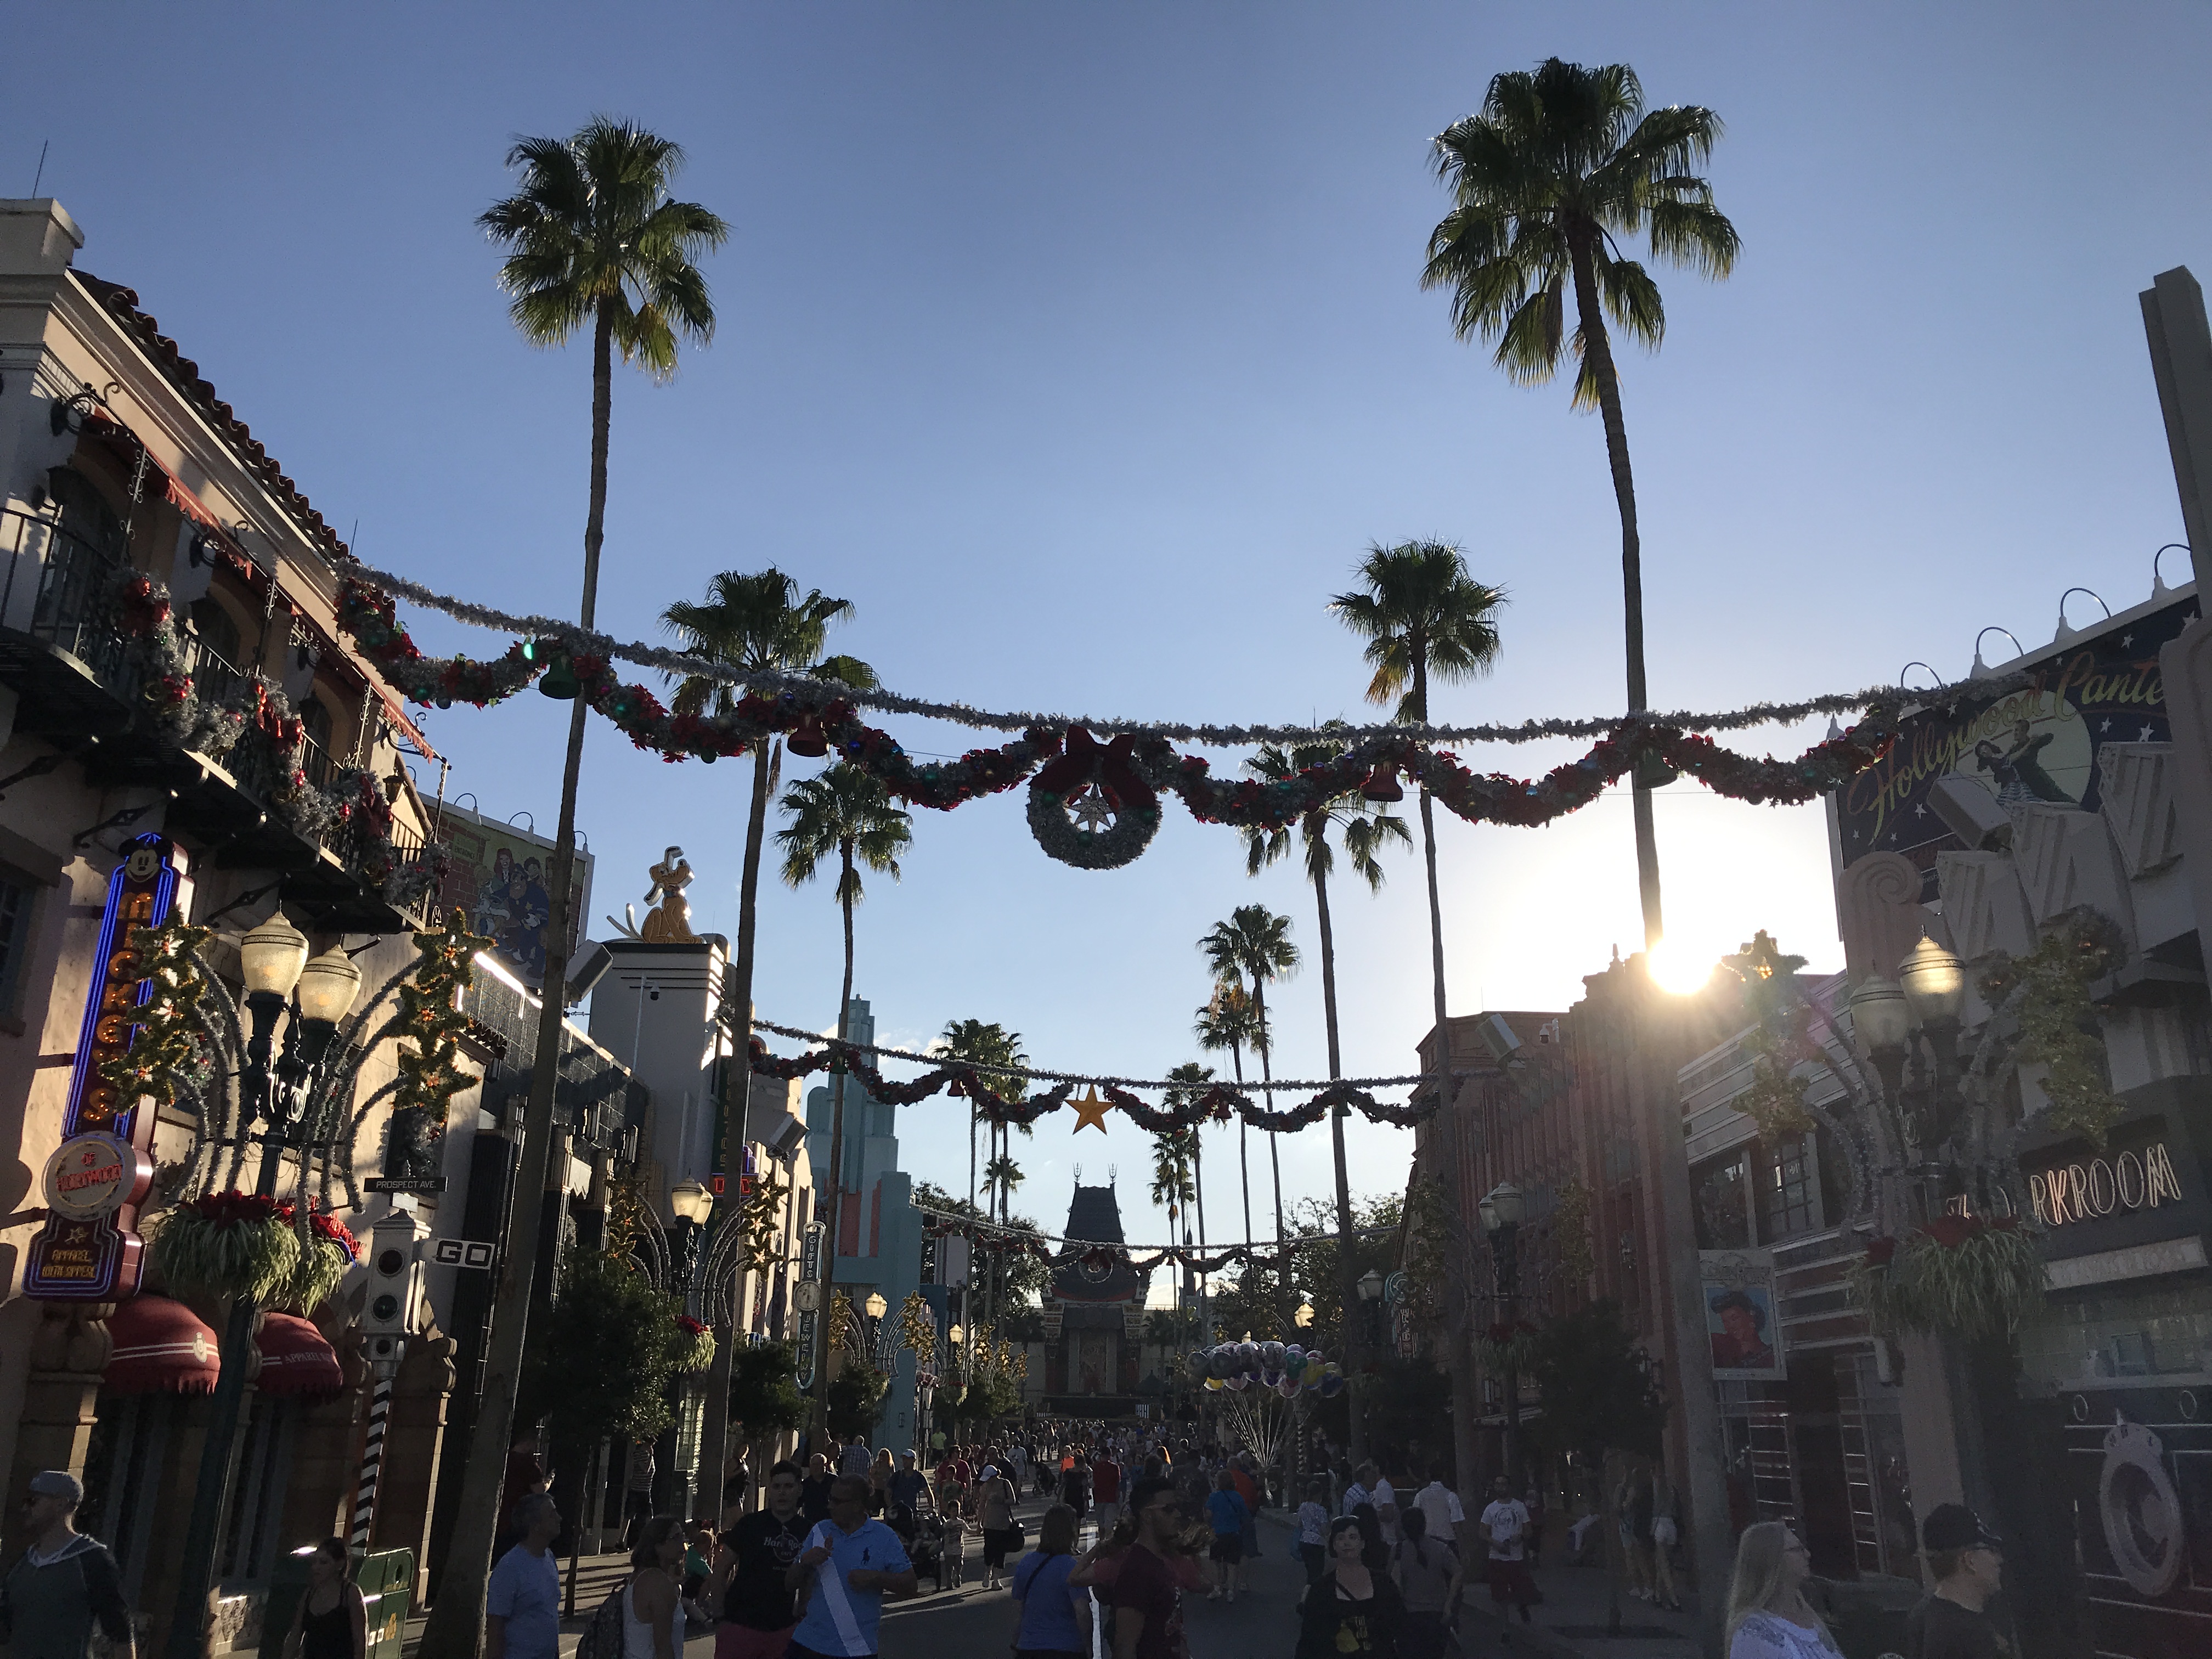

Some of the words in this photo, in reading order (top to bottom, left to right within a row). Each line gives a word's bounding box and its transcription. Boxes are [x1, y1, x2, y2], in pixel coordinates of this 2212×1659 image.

[1847, 670, 2049, 845] Hollywood
[2053, 650, 2164, 721] Cante
[1997, 1143, 2182, 1226] RKROOM
[436, 1240, 491, 1267] GO
[806, 1235, 816, 1278] GIFTS
